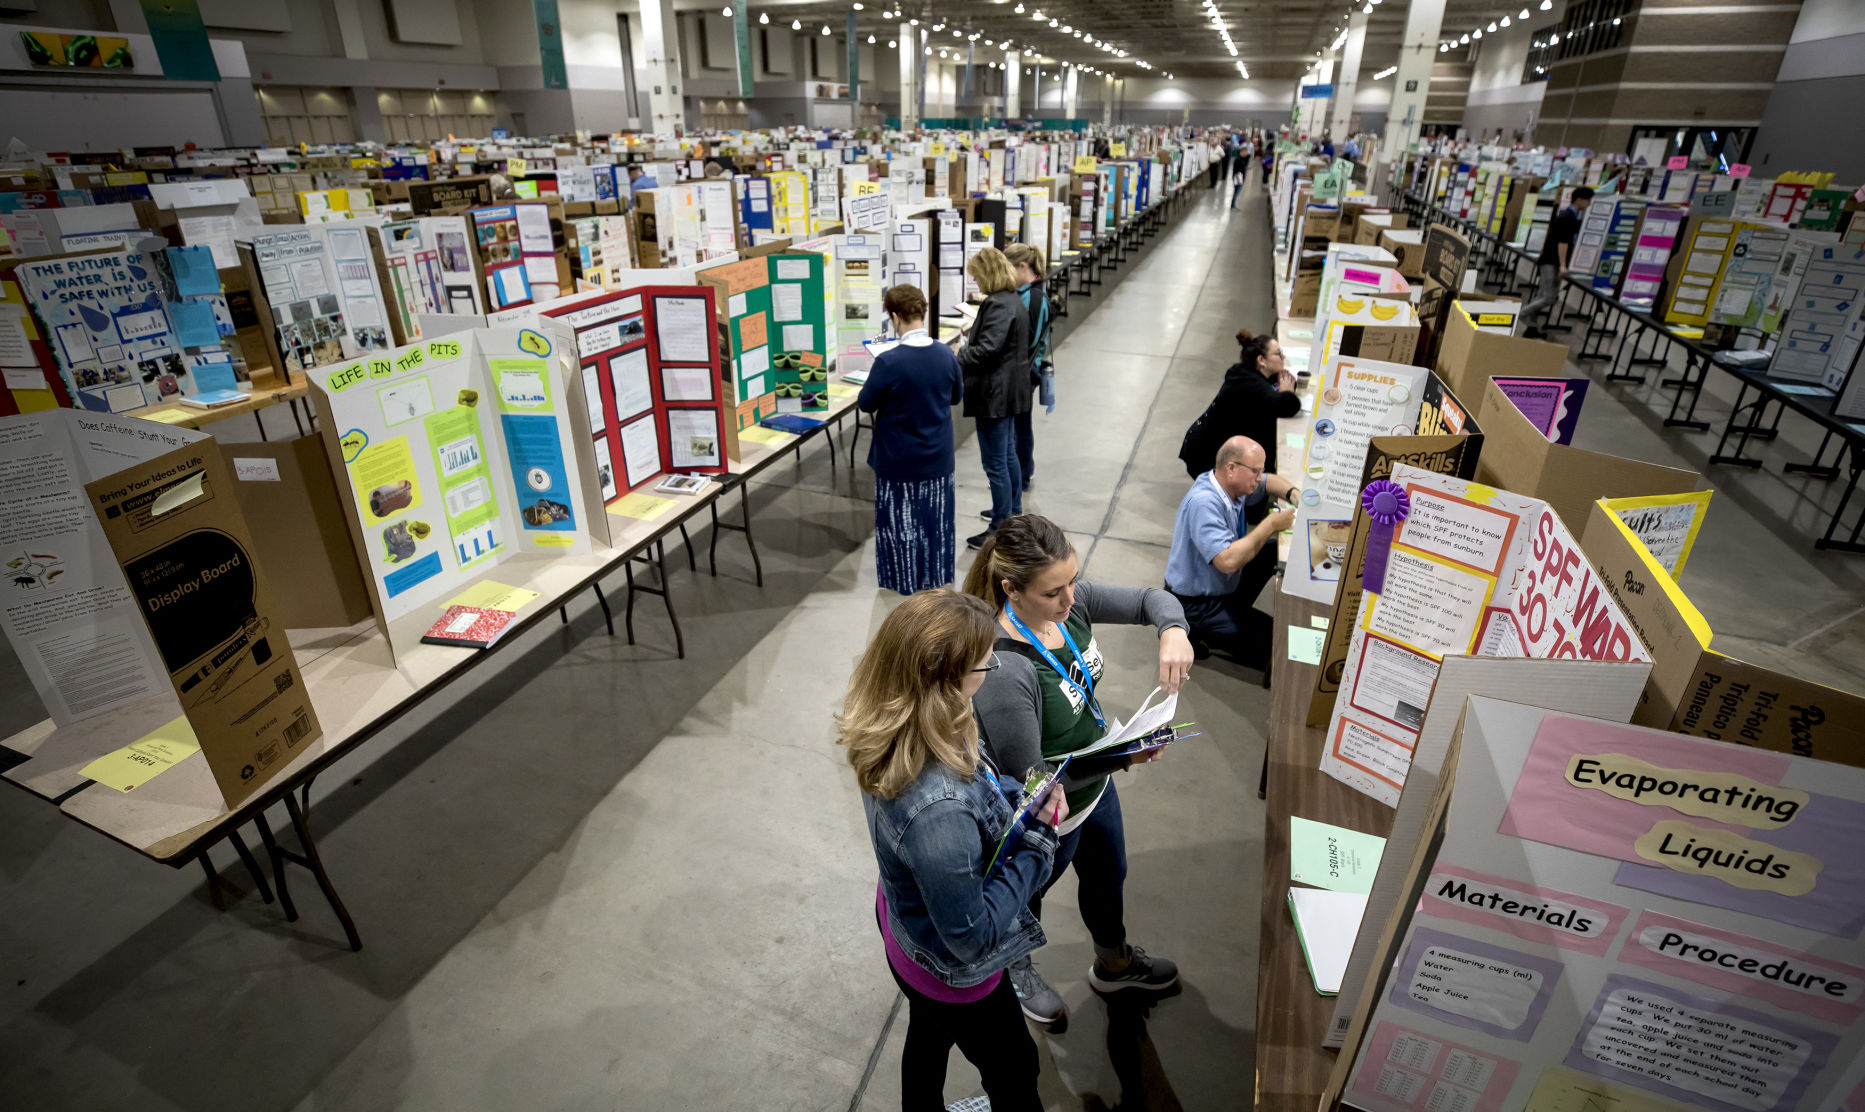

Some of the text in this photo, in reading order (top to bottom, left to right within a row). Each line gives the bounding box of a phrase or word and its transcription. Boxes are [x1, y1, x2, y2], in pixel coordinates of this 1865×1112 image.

[433, 190, 462, 202] BOARD
[464, 188, 476, 198] KIT
[1324, 179, 1337, 189] EA
[1703, 194, 1727, 206] EE
[32, 254, 143, 277] THE FUTURE OF
[54, 274, 102, 289] WATER
[59, 281, 155, 303] SAFE US
[331, 344, 458, 390] LIFE IN THE PITS
[1347, 371, 1396, 385] SUPPLIES
[78, 419, 177, 445] Does Caffeine Stunt Your
[1371, 452, 1456, 475] ArtSkills
[99, 488, 127, 503] Bring
[127, 478, 150, 491] Your
[152, 468, 176, 482] Ideas
[177, 463, 186, 472] to
[186, 456, 202, 468] Life
[1415, 496, 1445, 510] Purpose
[1410, 519, 1484, 546] which SPF protects
[1431, 513, 1468, 530] important
[1471, 525, 1480, 533] to
[1481, 528, 1502, 540] know
[1407, 528, 1485, 558] people from sunburn.
[1533, 511, 1581, 599] SPF
[1394, 551, 1434, 571] Hypothesis
[147, 577, 200, 612] Display
[200, 553, 241, 584] Board
[1389, 572, 1396, 580] My
[1398, 575, 1427, 589] hypothesis
[1434, 588, 1447, 596] that
[1448, 592, 1461, 602] they
[1408, 586, 1418, 594] the
[1623, 570, 1645, 596] Pacon
[1383, 594, 1419, 610] work the best
[1393, 590, 1423, 605] hypothesis
[1430, 602, 1440, 610] SPF
[1519, 570, 1546, 643] 30
[1599, 566, 1615, 590] Tri-Fold
[1612, 589, 1641, 630] Presentation
[1379, 608, 1415, 624] work the best
[1381, 601, 1388, 609] My
[1390, 604, 1418, 619] hypothesis
[1426, 617, 1436, 625] SPF
[1375, 623, 1387, 631] work
[1377, 615, 1384, 623] My
[1386, 619, 1413, 633] hypothesis
[1421, 632, 1431, 640] SPF
[1374, 639, 1411, 660] Background
[1683, 671, 1722, 729] Panneau
[1740, 690, 1779, 741] Tri-Fold
[1350, 724, 1380, 742] Materials
[1789, 704, 1826, 757] Pacon
[1573, 758, 1800, 823] Evaporating
[1328, 836, 1339, 878] 2-CH105-C
[1658, 833, 1790, 880] Liquids
[1438, 880, 1592, 932] Materials
[1419, 971, 1442, 981] Soda
[1424, 960, 1454, 972] Water
[1438, 952, 1485, 969] measuring
[1488, 965, 1509, 975] cups
[1513, 970, 1532, 981] (ml)
[1658, 932, 1848, 996] Procedure
[1412, 993, 1429, 1002] Tea
[1415, 982, 1469, 1000] Apple Juice
[1626, 994, 1644, 1003] We
[1647, 1000, 1673, 1013] used
[1689, 1014, 1736, 1032] separate
[1741, 1028, 1798, 1050] measuring
[1642, 1023, 1669, 1037] apple
[1672, 1032, 1699, 1045] juice
[1703, 1040, 1723, 1050] and
[1727, 1047, 1753, 1059] soda
[1757, 1055, 1779, 1067] into
[1652, 1013, 1785, 1058] We put 30 ml of water.
[1605, 1034, 1768, 1088] uncovered and measured them
[1610, 1024, 1760, 1074] each We set them out
[1595, 1053, 1643, 1073] for seven
[1600, 1043, 1762, 1098] at the end of each school day
